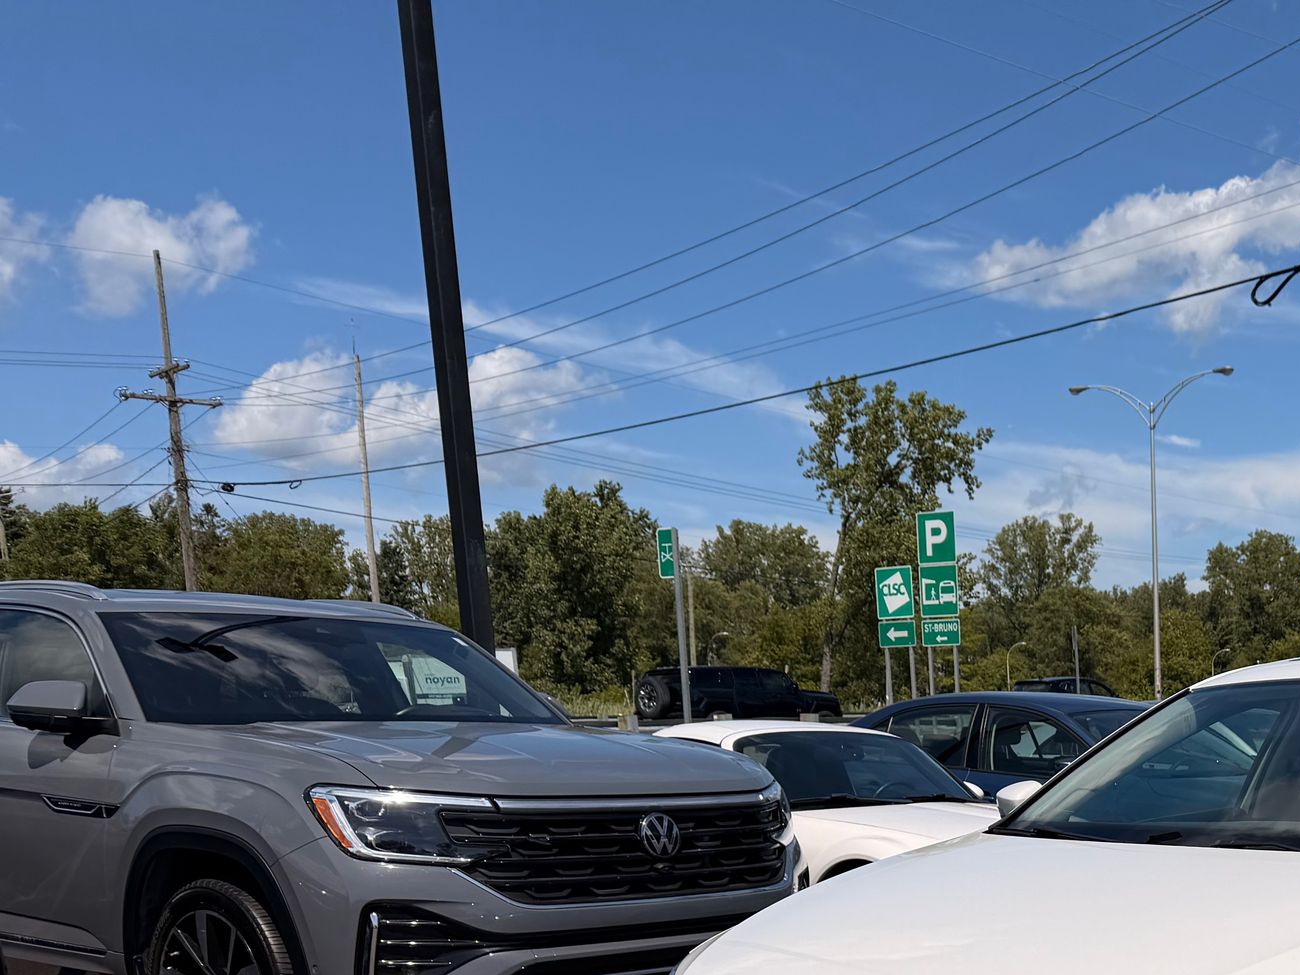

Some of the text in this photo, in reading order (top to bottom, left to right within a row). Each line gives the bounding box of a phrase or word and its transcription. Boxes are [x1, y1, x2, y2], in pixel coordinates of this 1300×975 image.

[924, 519, 948, 557] P
[881, 582, 906, 597] CLSC
[924, 622, 958, 633] ST-BRUNO
[425, 676, 461, 687] noyan
